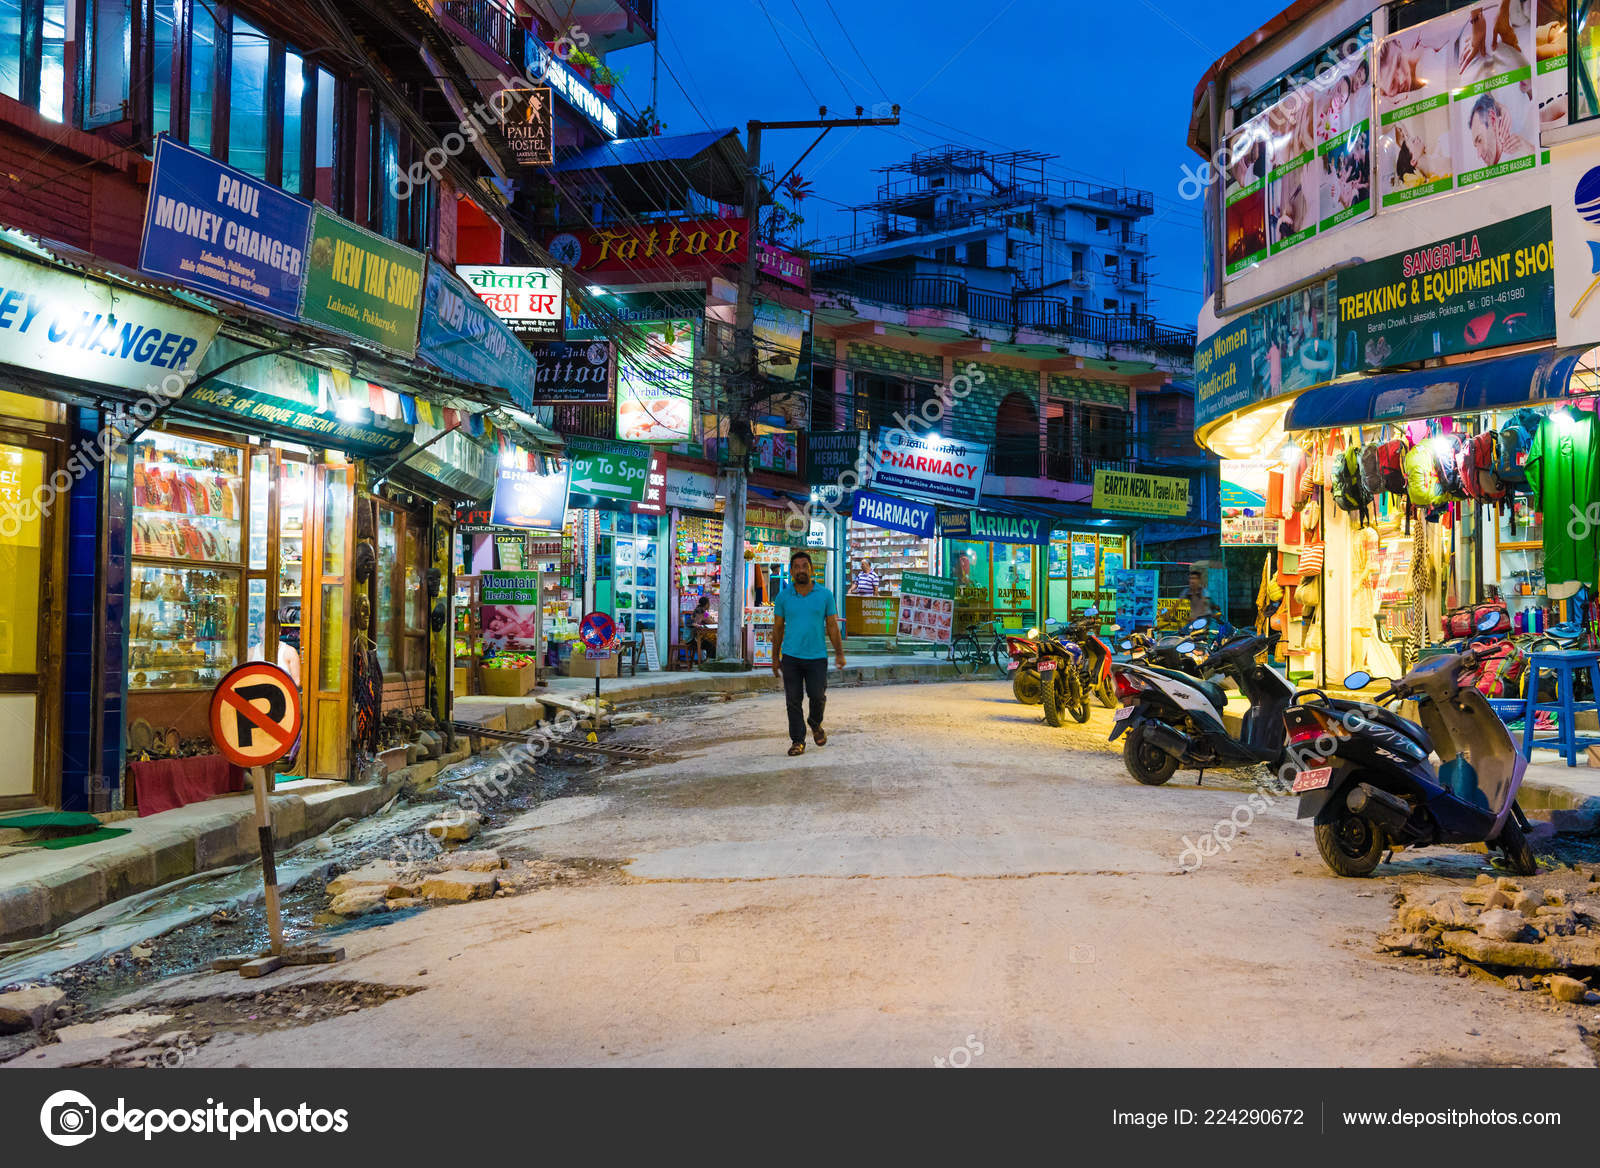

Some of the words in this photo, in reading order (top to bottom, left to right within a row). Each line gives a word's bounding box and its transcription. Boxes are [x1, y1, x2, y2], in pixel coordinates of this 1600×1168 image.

[1484, 74, 1509, 90] MASSAGE
[507, 126, 545, 139] PAILA
[508, 139, 546, 151] HOSTEL
[218, 173, 260, 219] PAUL
[1400, 188, 1412, 199] FACE
[1412, 183, 1435, 197] MASSAGE
[154, 195, 223, 245] MONEY
[224, 221, 302, 276] CHANGER
[581, 226, 741, 272] Tattoo
[1403, 234, 1481, 278] SANGRI-LA
[332, 239, 363, 289] NEW
[363, 251, 388, 299] YAK
[387, 262, 420, 311] SHOP
[469, 270, 550, 289] चौतारी
[1339, 281, 1407, 322] TREKKING
[1411, 278, 1421, 305] &
[1424, 252, 1510, 304] EQUIPMENT
[529, 294, 558, 315] घर
[1387, 316, 1408, 329] Chowk,
[1410, 310, 1438, 324] Lakeside,
[1439, 303, 1466, 317] Pokhara,
[1480, 287, 1525, 308] 061-461980
[0, 286, 43, 334] EY
[47, 308, 198, 372] CHANGER
[1213, 327, 1248, 361] Women
[537, 361, 607, 383] attoo
[1198, 361, 1237, 403] Handicraft
[192, 386, 235, 408] HOUSE
[234, 396, 253, 411] OF
[252, 402, 294, 424] UNIQUE
[293, 412, 336, 433] TIBETAN
[334, 422, 391, 449] HANDICRAFT
[631, 446, 650, 458] Spa
[809, 435, 857, 449] MOUNTAIN
[597, 458, 614, 475] To
[618, 460, 646, 481] Spa
[814, 451, 850, 465] HERBAL
[880, 449, 978, 481] PHARMACY
[822, 467, 840, 481] SPA
[881, 474, 903, 485] Trekking
[904, 479, 929, 489] Medicine
[929, 482, 955, 493] Available
[1104, 475, 1129, 496] EARTH
[1129, 476, 1151, 499] NEPAL
[1153, 479, 1171, 500] Travel
[1175, 481, 1187, 502] Trek
[858, 497, 929, 531] PHARMACY
[497, 536, 524, 544] OPEN
[482, 573, 537, 590] Mountain
[486, 590, 513, 601] Herbal
[514, 590, 532, 602] Spa
[235, 682, 287, 748] P
